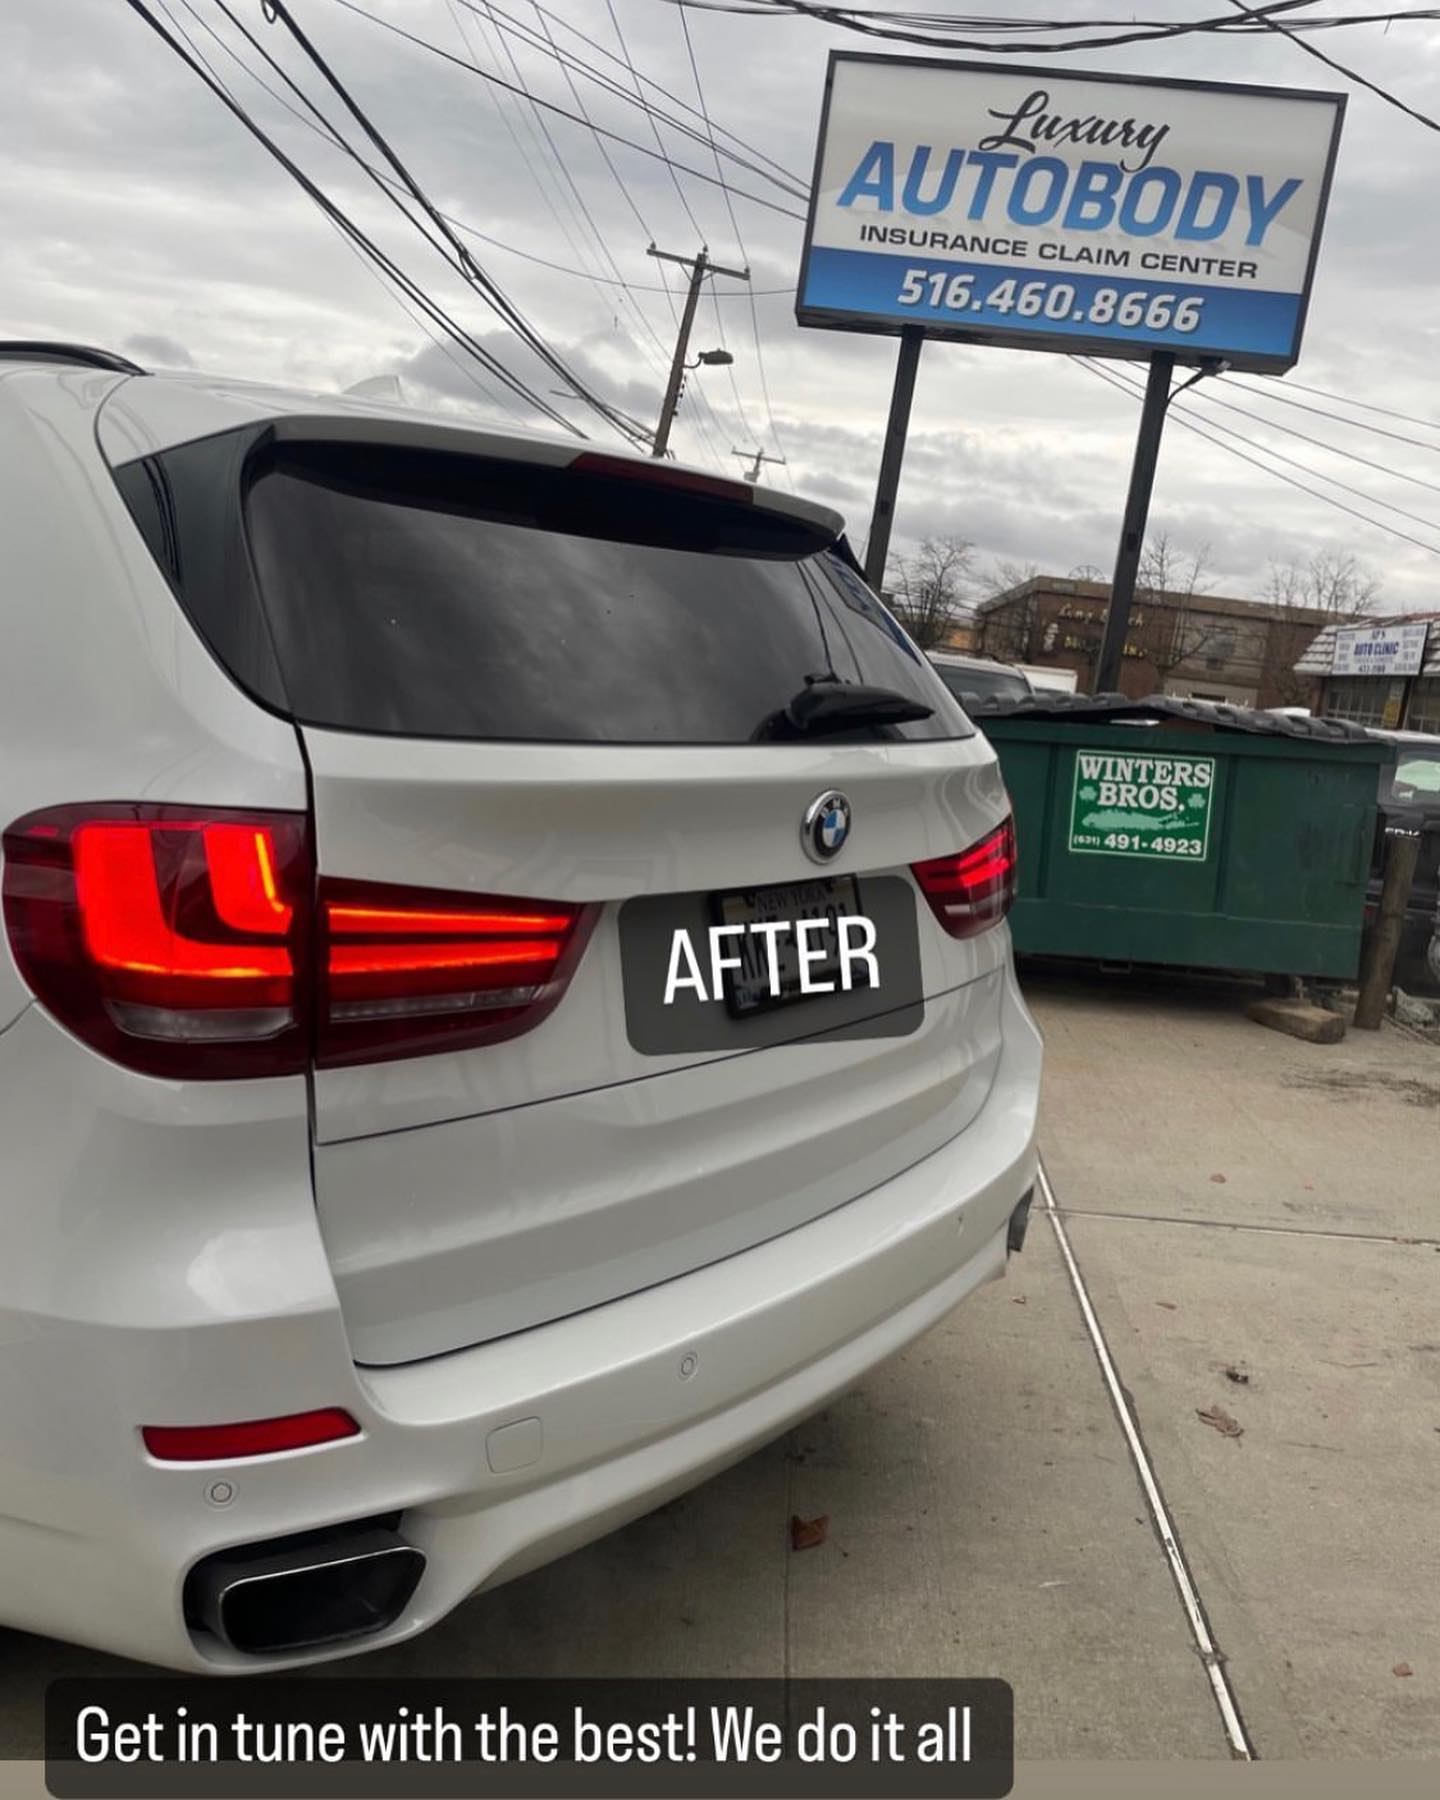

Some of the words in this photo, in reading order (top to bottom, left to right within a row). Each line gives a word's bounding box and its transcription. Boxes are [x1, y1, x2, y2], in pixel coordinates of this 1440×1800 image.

[978, 90, 1171, 172] Luxury
[836, 140, 1304, 248] AUTOBODY
[859, 223, 1028, 258] INSURANCE
[1038, 243, 1131, 269] CLAIM
[1140, 252, 1259, 280] CENTER
[897, 269, 1205, 335] 516.460.8666
[1354, 642, 1373, 656] AUTO
[1374, 641, 1399, 656] CLINIC
[1079, 755, 1212, 788] WINTERS
[1097, 782, 1185, 812] BROS.
[1104, 833, 1203, 856] 491-4923
